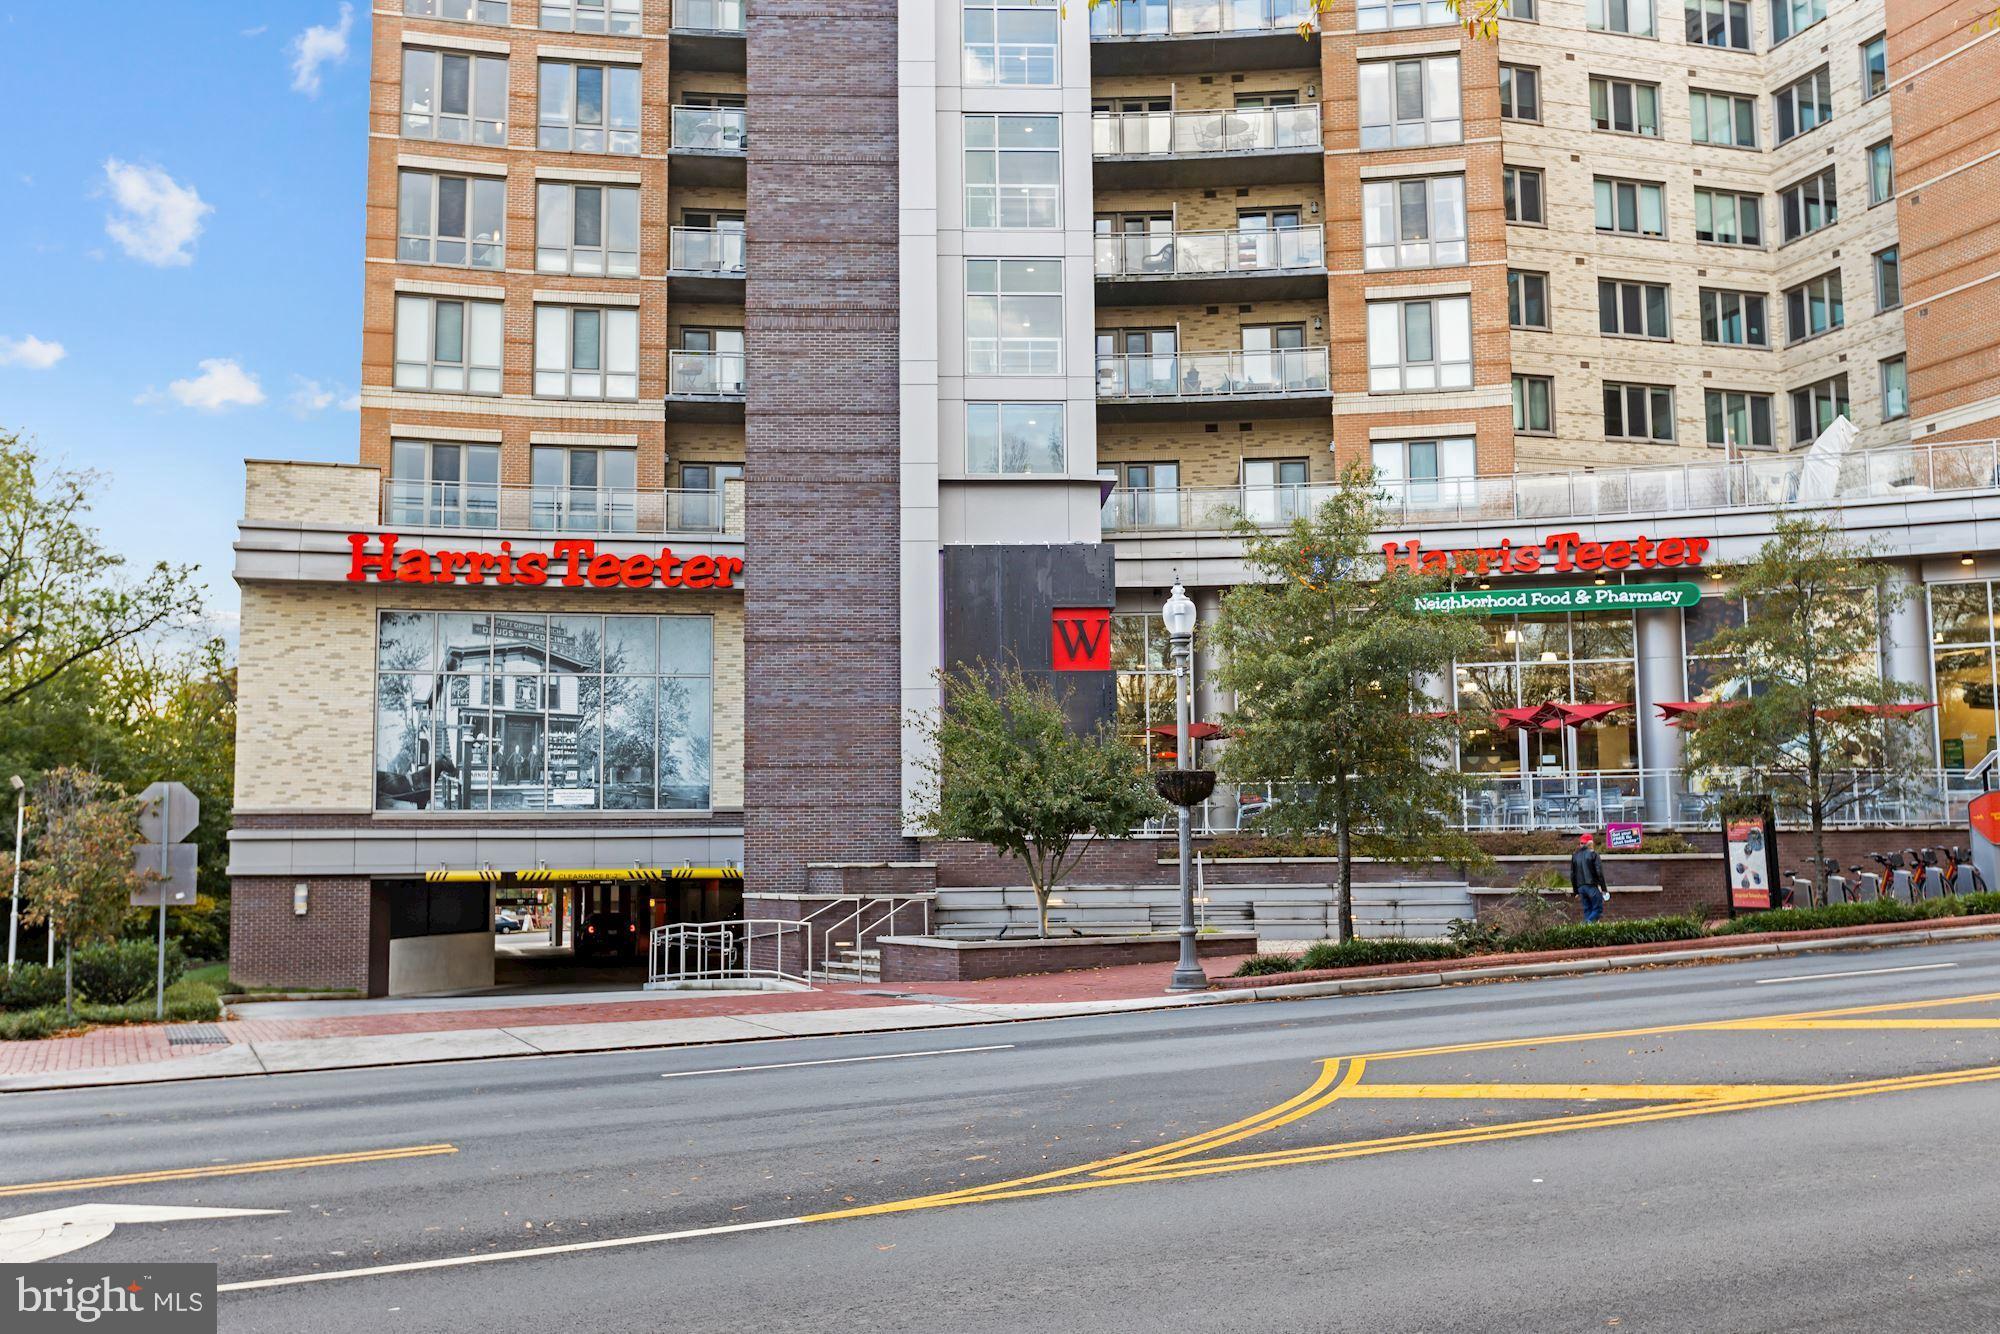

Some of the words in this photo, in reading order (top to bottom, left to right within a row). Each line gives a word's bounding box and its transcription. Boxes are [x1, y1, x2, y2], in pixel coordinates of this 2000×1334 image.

[346, 533, 548, 586] Harris
[553, 538, 744, 589] Teeter
[1382, 538, 1542, 576] Harris
[1545, 532, 1710, 573] Teeter
[1414, 592, 1528, 613] Neighborhood
[1531, 591, 1572, 606] Food
[1574, 589, 1592, 605] &
[1595, 589, 1683, 605] Pharmacy
[482, 625, 515, 637] DUGS
[527, 632, 569, 645] MEDCINE
[1053, 619, 1109, 662] W
[558, 873, 604, 881] CLEARANCE
